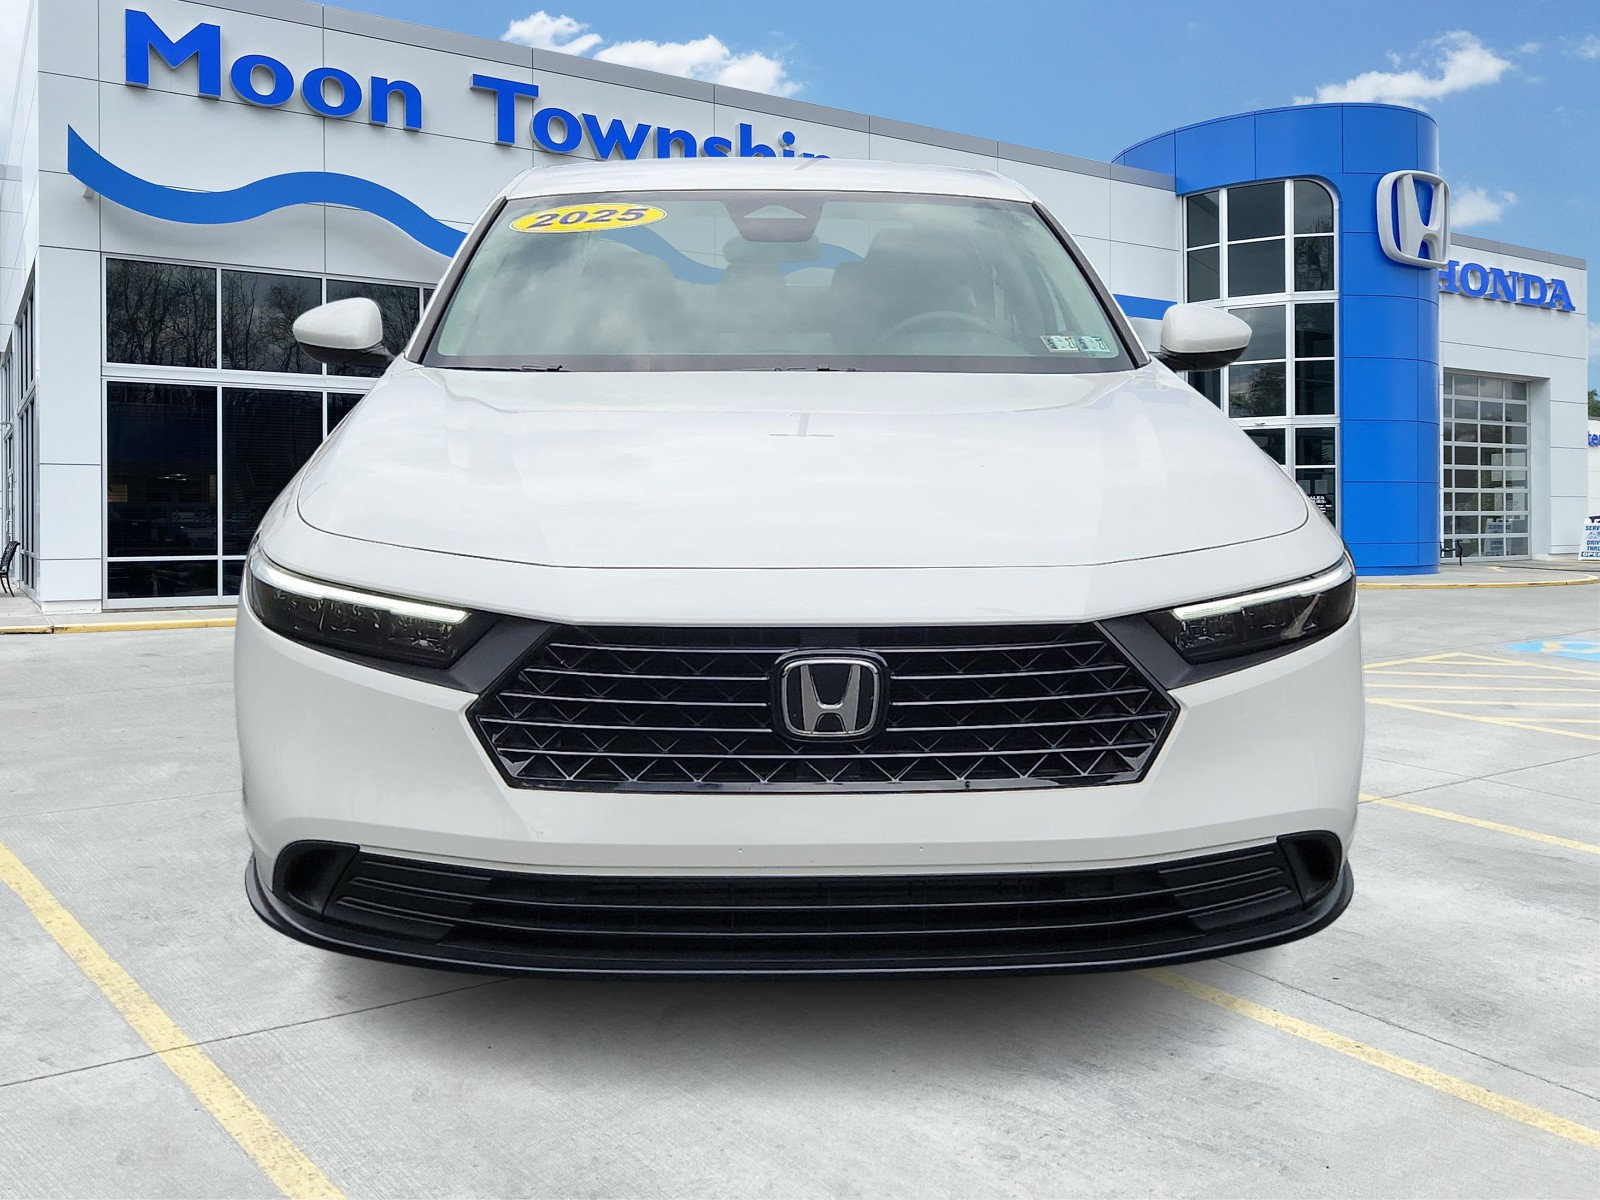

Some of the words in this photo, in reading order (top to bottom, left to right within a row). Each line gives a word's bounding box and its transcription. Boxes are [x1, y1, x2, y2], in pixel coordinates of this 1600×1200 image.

[126, 10, 422, 131] Moon
[471, 74, 833, 160] Townshi
[526, 208, 648, 229] 2025
[1438, 259, 1576, 312] HONDA
